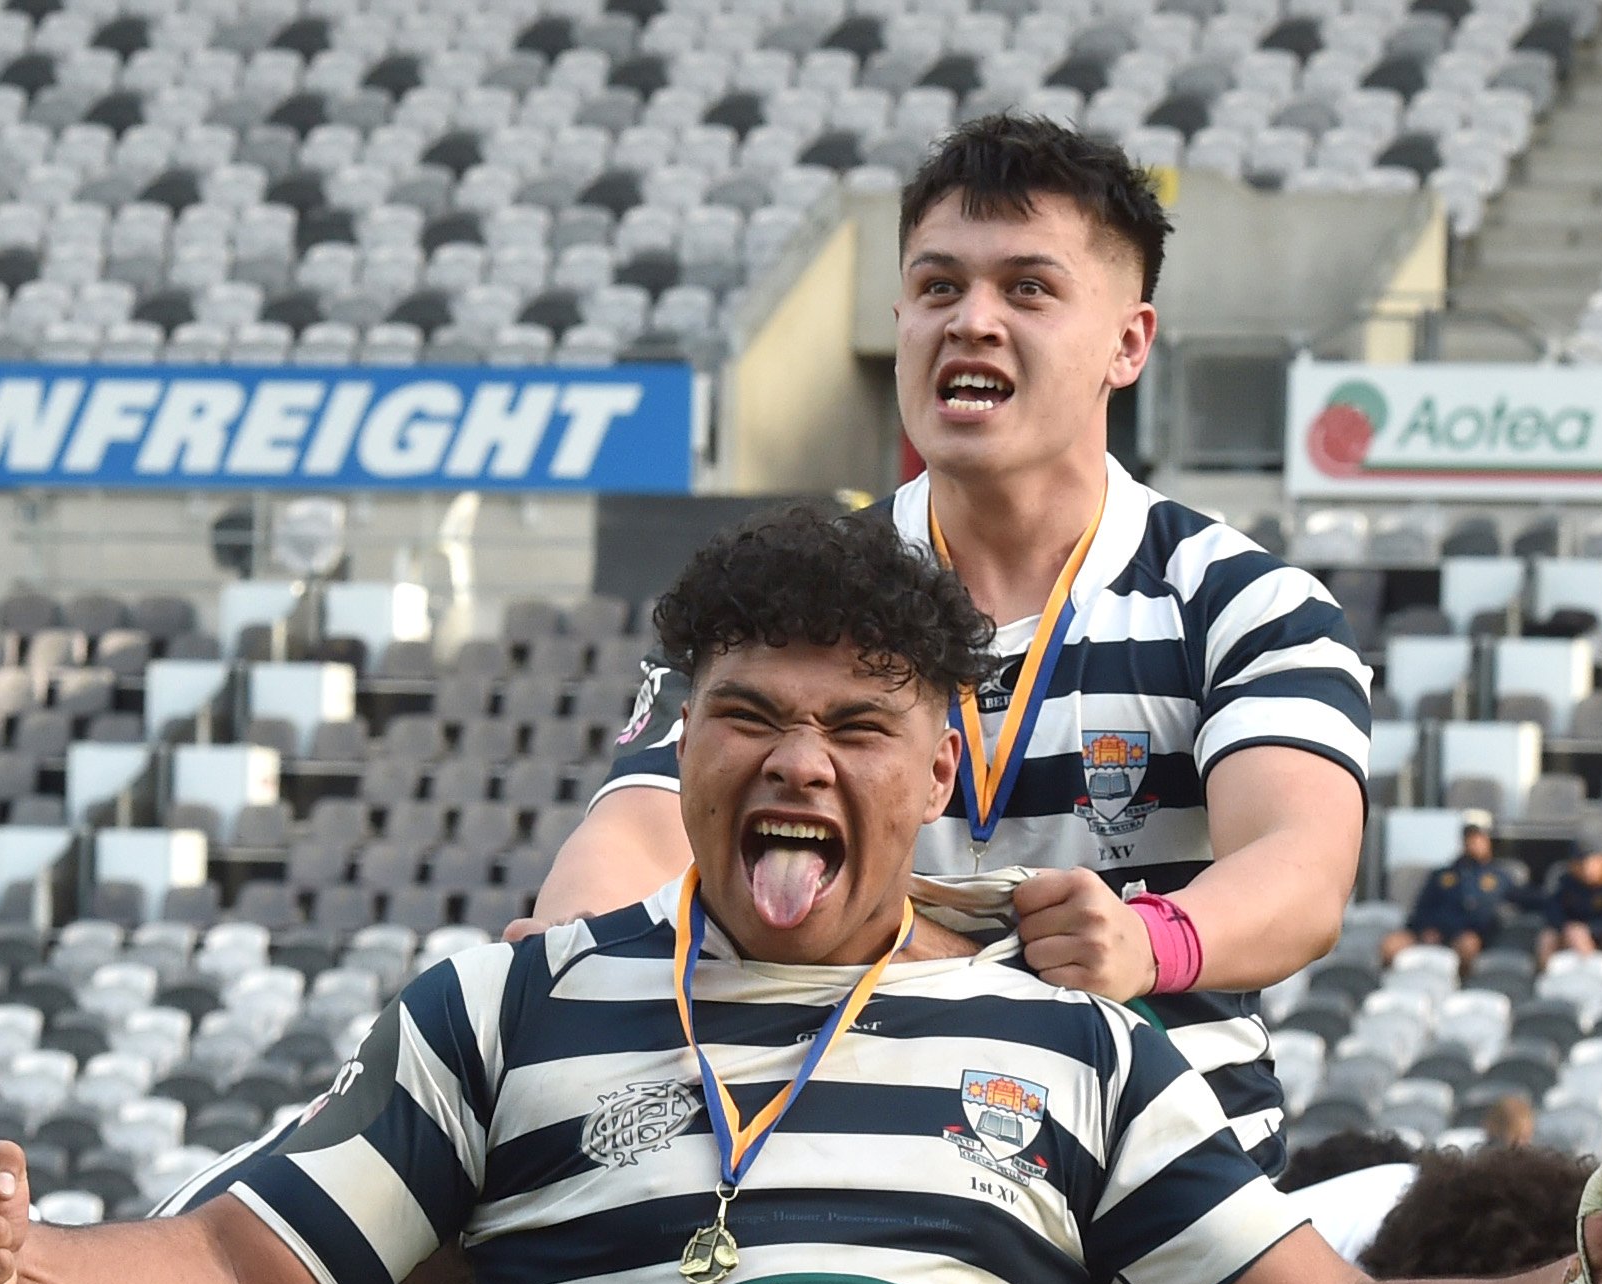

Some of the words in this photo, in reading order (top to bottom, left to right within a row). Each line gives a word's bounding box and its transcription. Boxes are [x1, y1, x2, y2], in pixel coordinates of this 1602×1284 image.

[1395, 396, 1595, 452] Aotea
[969, 1176, 993, 1195] 1st
[996, 1184, 1020, 1206] XV
